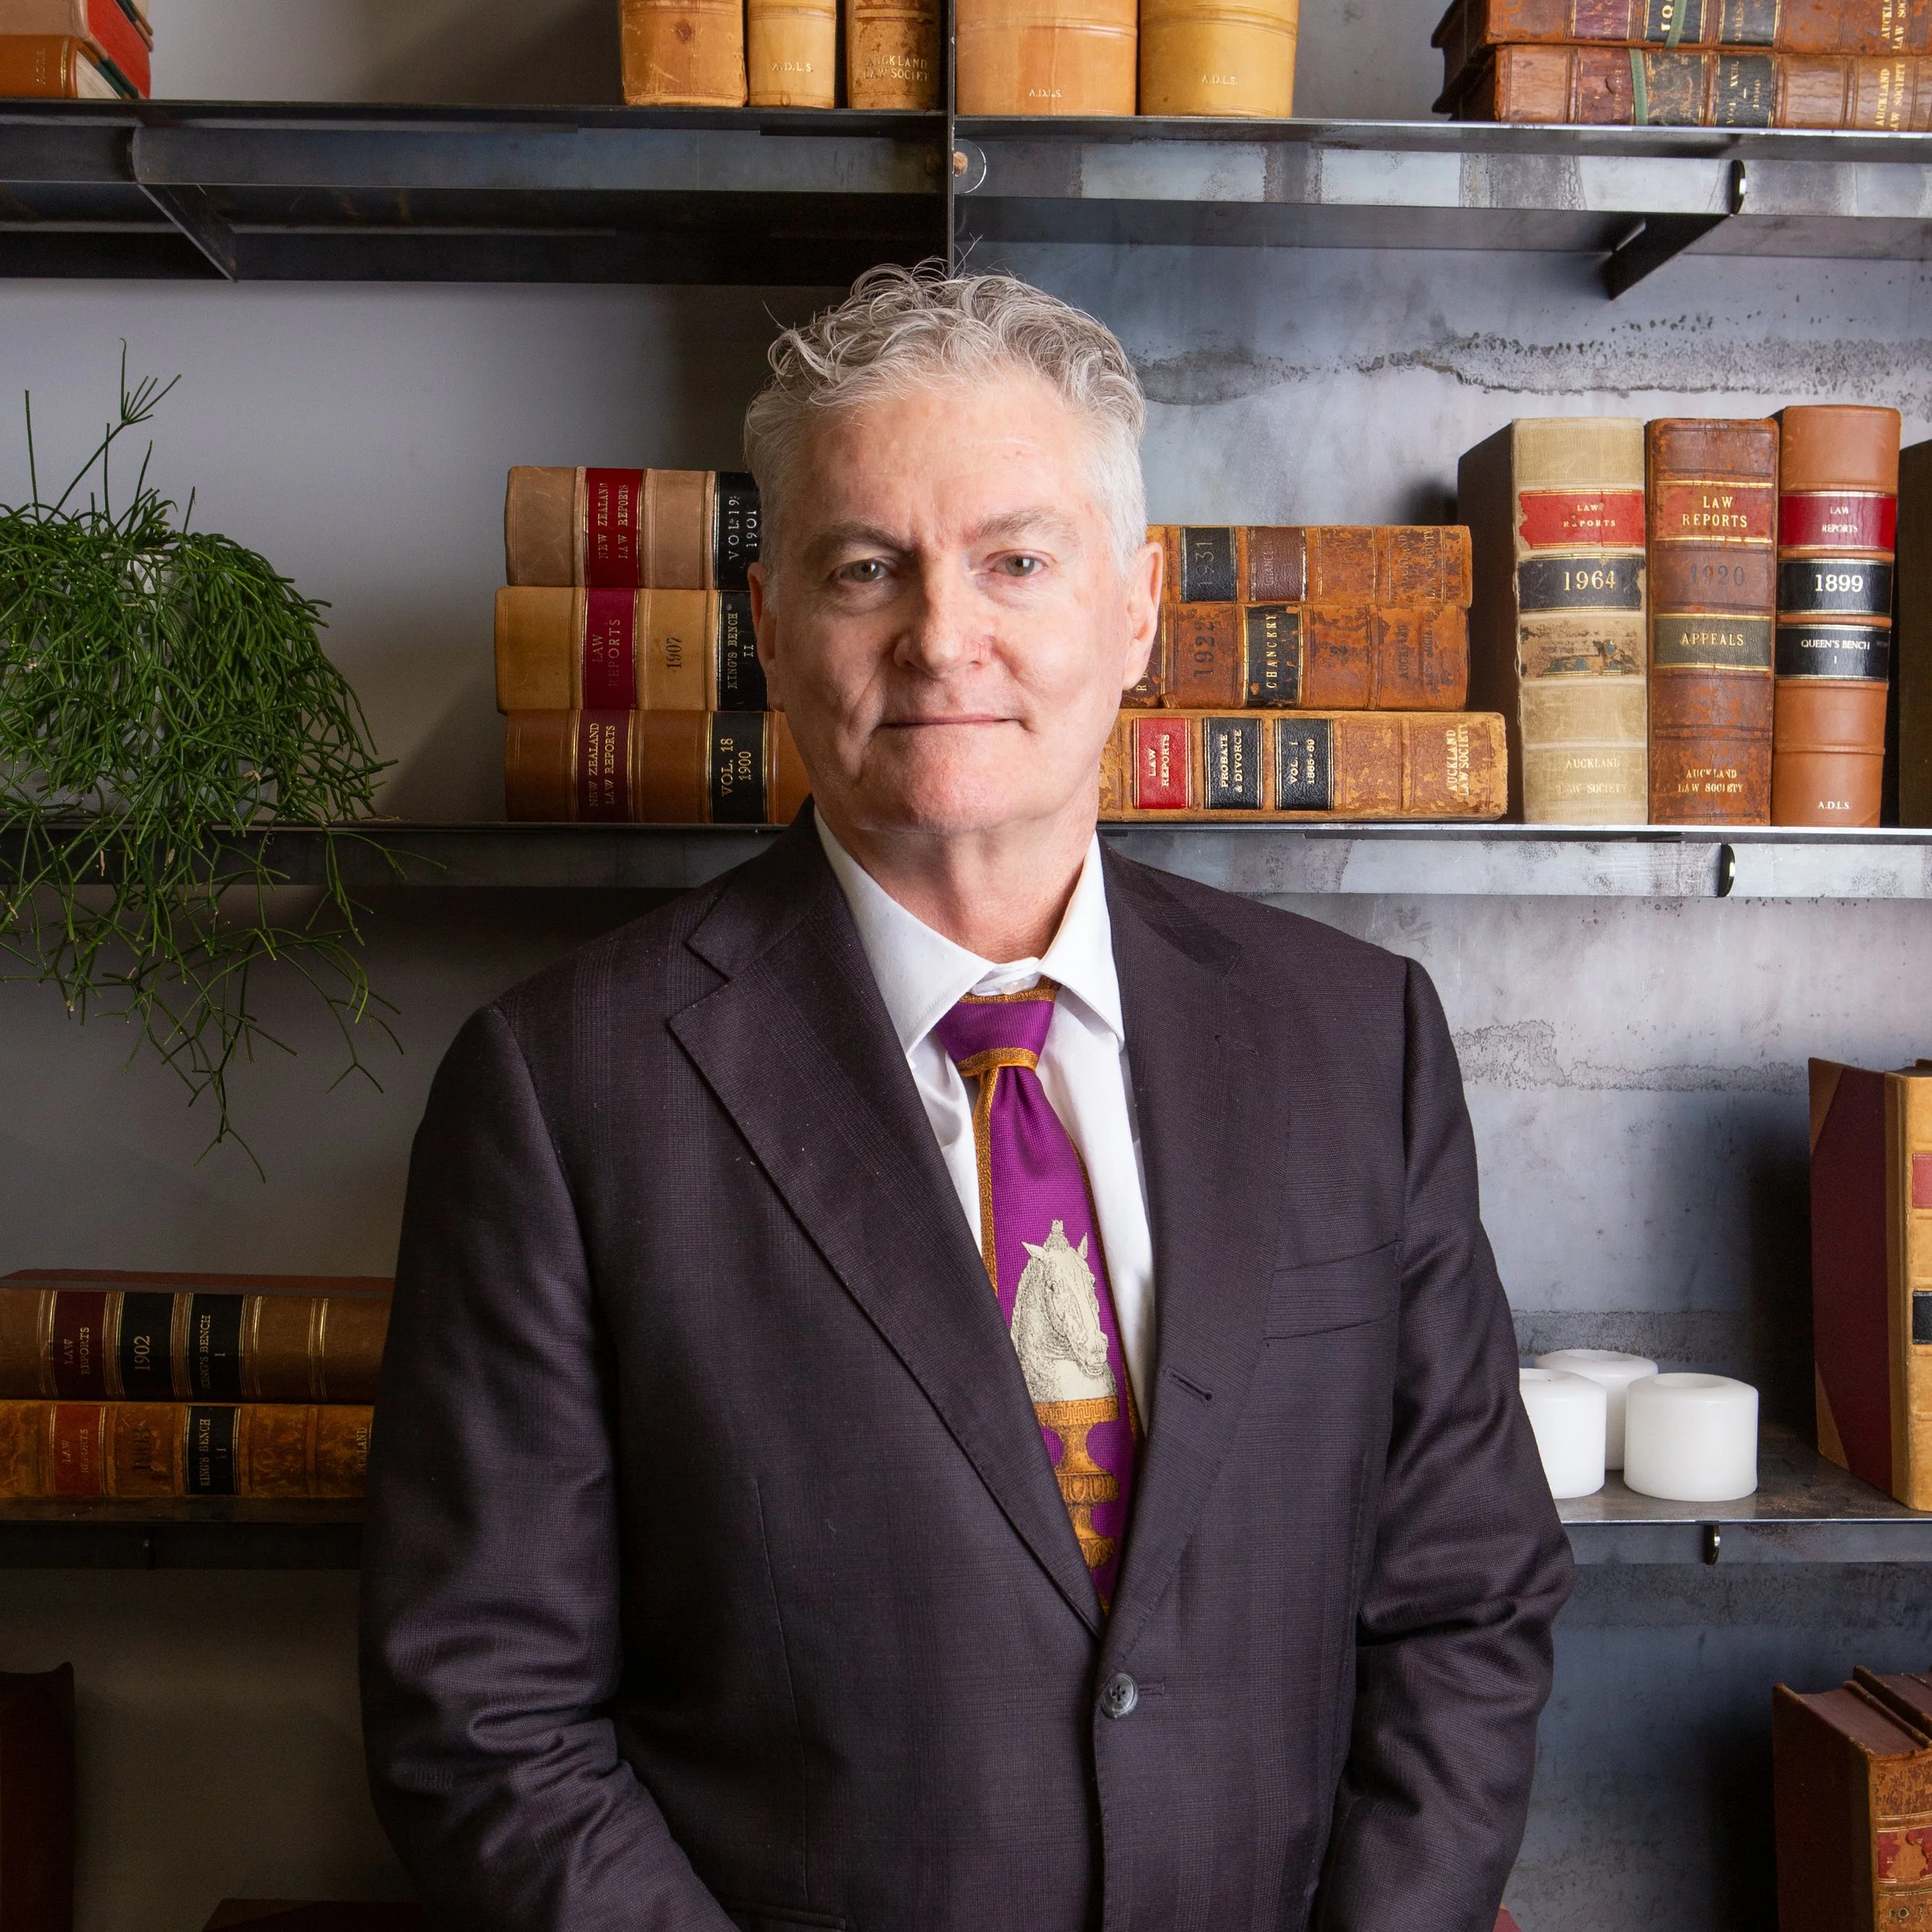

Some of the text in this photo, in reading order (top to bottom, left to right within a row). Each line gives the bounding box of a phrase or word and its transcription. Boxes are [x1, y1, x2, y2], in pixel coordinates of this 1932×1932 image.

[1892, 24, 1905, 50] LAW
[772, 61, 814, 73] A.D.L.S.
[1876, 69, 1890, 127] AUCKLAND
[1889, 63, 1906, 131] AW SOCIETY
[1577, 504, 1599, 512] LAW
[1702, 495, 1733, 509] LAW
[1830, 505, 1849, 515] LAW
[597, 483, 608, 560] NEW ZEALAND
[618, 485, 628, 559] LAW REPORTS
[1682, 514, 1748, 528] REPORTS
[1821, 523, 1859, 533] REPORTS
[1195, 541, 1214, 587] 1931
[1691, 563, 1746, 587] 1920
[1563, 570, 1616, 591] 1964
[1815, 573, 1864, 593] 1899
[591, 634, 604, 663] LAW
[607, 618, 621, 688] REPORTS
[665, 636, 682, 670] 1907
[727, 612, 739, 689] KING'S BENCH
[1193, 621, 1214, 678] 1922
[1264, 614, 1278, 689] CHANCERY
[1681, 632, 1745, 647] APPEALS
[1801, 639, 1870, 650] QUEEN'S BENCH
[588, 722, 599, 808] NEW ZEALAND
[604, 725, 616, 805] LAW REPORTS
[719, 736, 733, 798] VOL. 18
[738, 750, 752, 781] 1900
[1148, 748, 1158, 777] LAW
[1161, 733, 1171, 787] REPORTS
[1219, 733, 1229, 789] PROBATE
[1234, 728, 1243, 794] & DIVORCE
[1290, 757, 1299, 784] VOL.
[1447, 729, 1458, 793] AUCKLAND
[1458, 723, 1469, 797] LAW SOCIETY
[1566, 758, 1621, 769] AUCKLAND
[1678, 783, 1743, 794] LAW SOCIETY
[1818, 800, 1851, 810] A.D.L.S.
[199, 1315, 211, 1353] BENCH
[64, 1338, 74, 1366] LAW
[79, 1326, 90, 1376] REPORTS
[134, 1335, 151, 1372] 1902
[62, 1439, 71, 1462] LAW
